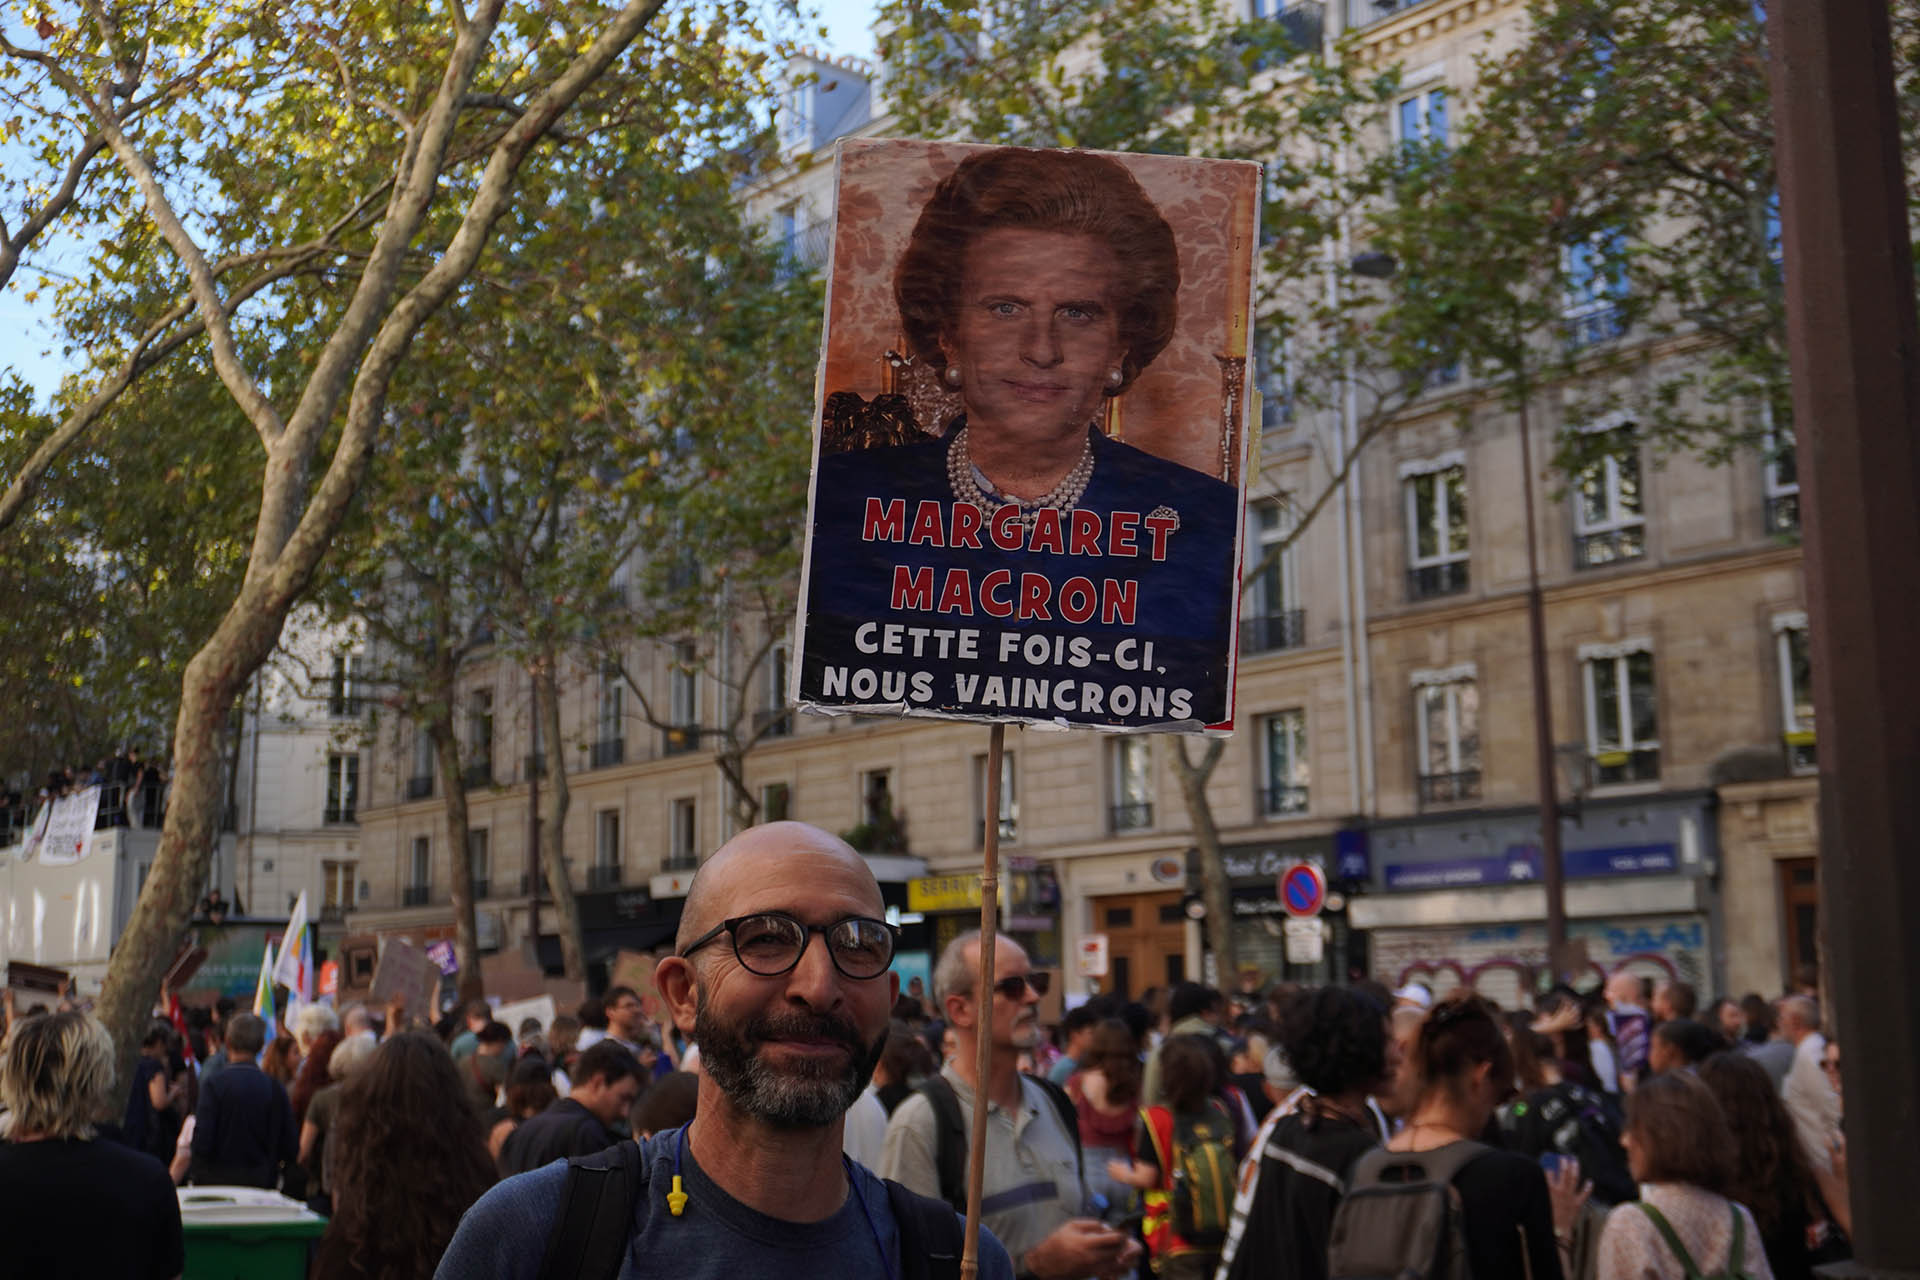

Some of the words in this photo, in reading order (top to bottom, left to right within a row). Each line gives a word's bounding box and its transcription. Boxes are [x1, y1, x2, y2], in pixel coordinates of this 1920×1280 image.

[862, 497, 1178, 561] MARGARET
[890, 565, 1138, 625] MACRON
[854, 622, 979, 660] CETTE
[998, 632, 1167, 675] FOIS-CI,
[822, 666, 934, 702] NOUS
[955, 673, 1194, 720] VAINCRONS
